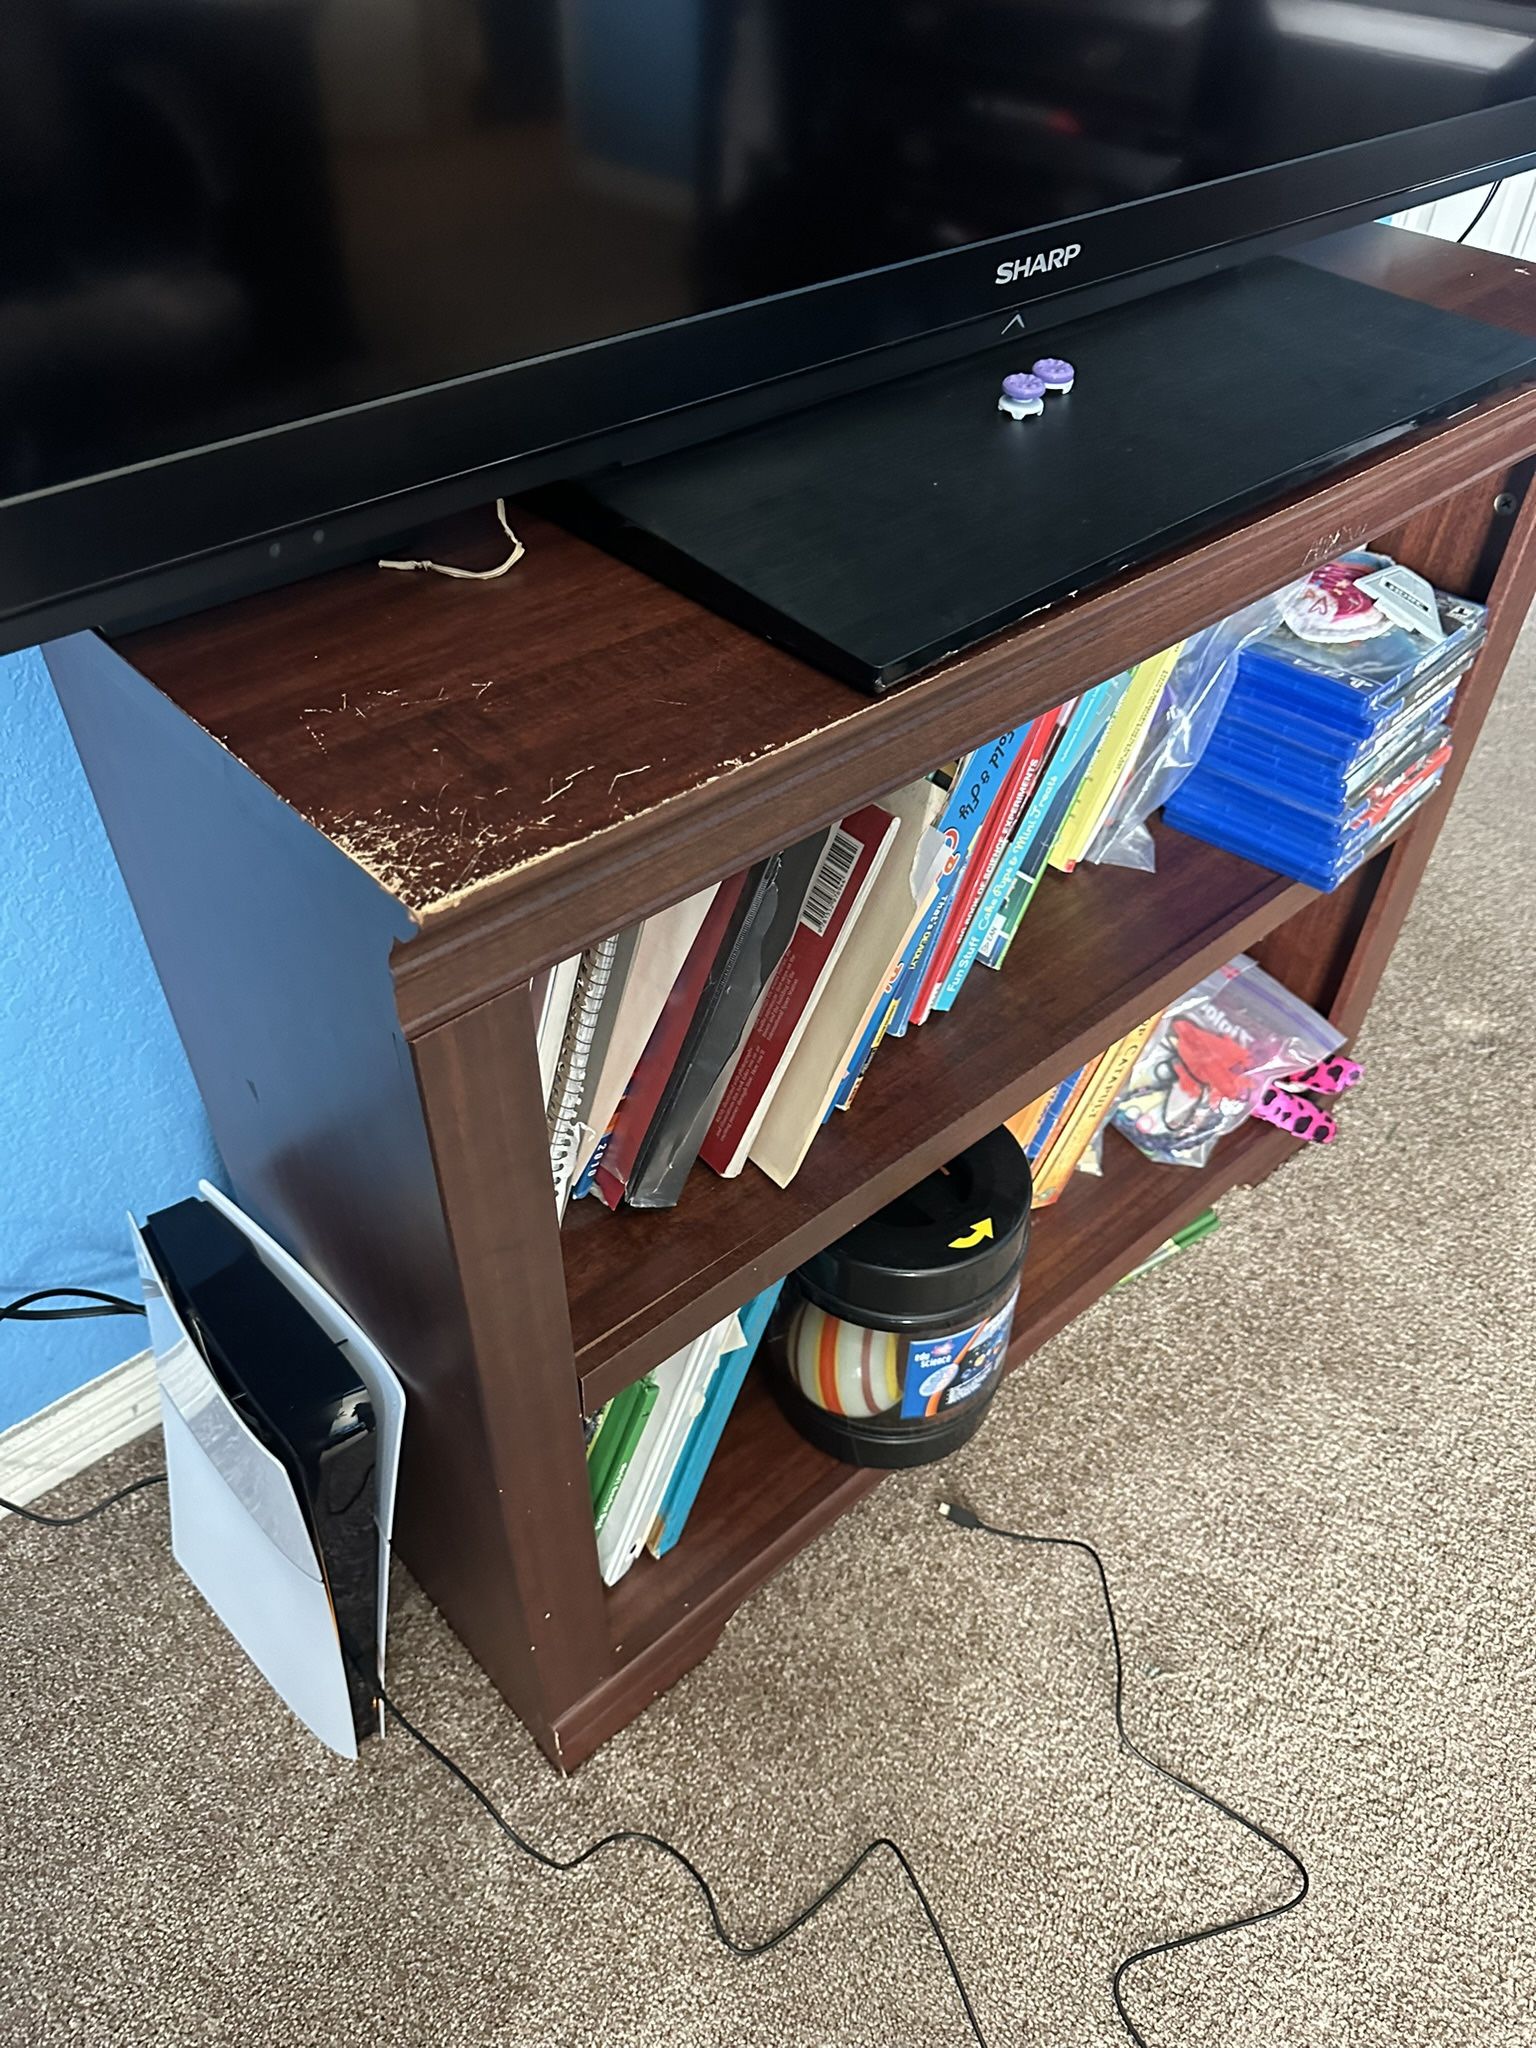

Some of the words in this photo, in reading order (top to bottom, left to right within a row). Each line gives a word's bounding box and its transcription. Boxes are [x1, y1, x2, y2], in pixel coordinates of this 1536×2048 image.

[995, 244, 1081, 284] SHARP
[959, 783, 982, 821] Fly
[1002, 758, 1040, 840] EXPERIMENTS
[947, 964, 965, 993] Fun
[958, 936, 980, 971] Stuff
[977, 901, 996, 932] Cake
[991, 864, 1014, 900] Pops
[1011, 817, 1035, 855] Mini
[1029, 774, 1059, 819] Treats
[927, 894, 949, 934] That's
[988, 926, 998, 943] EAN
[1089, 1044, 1138, 1118] CATAPULT
[587, 1143, 608, 1177] 2010
[920, 1354, 952, 1368] science
